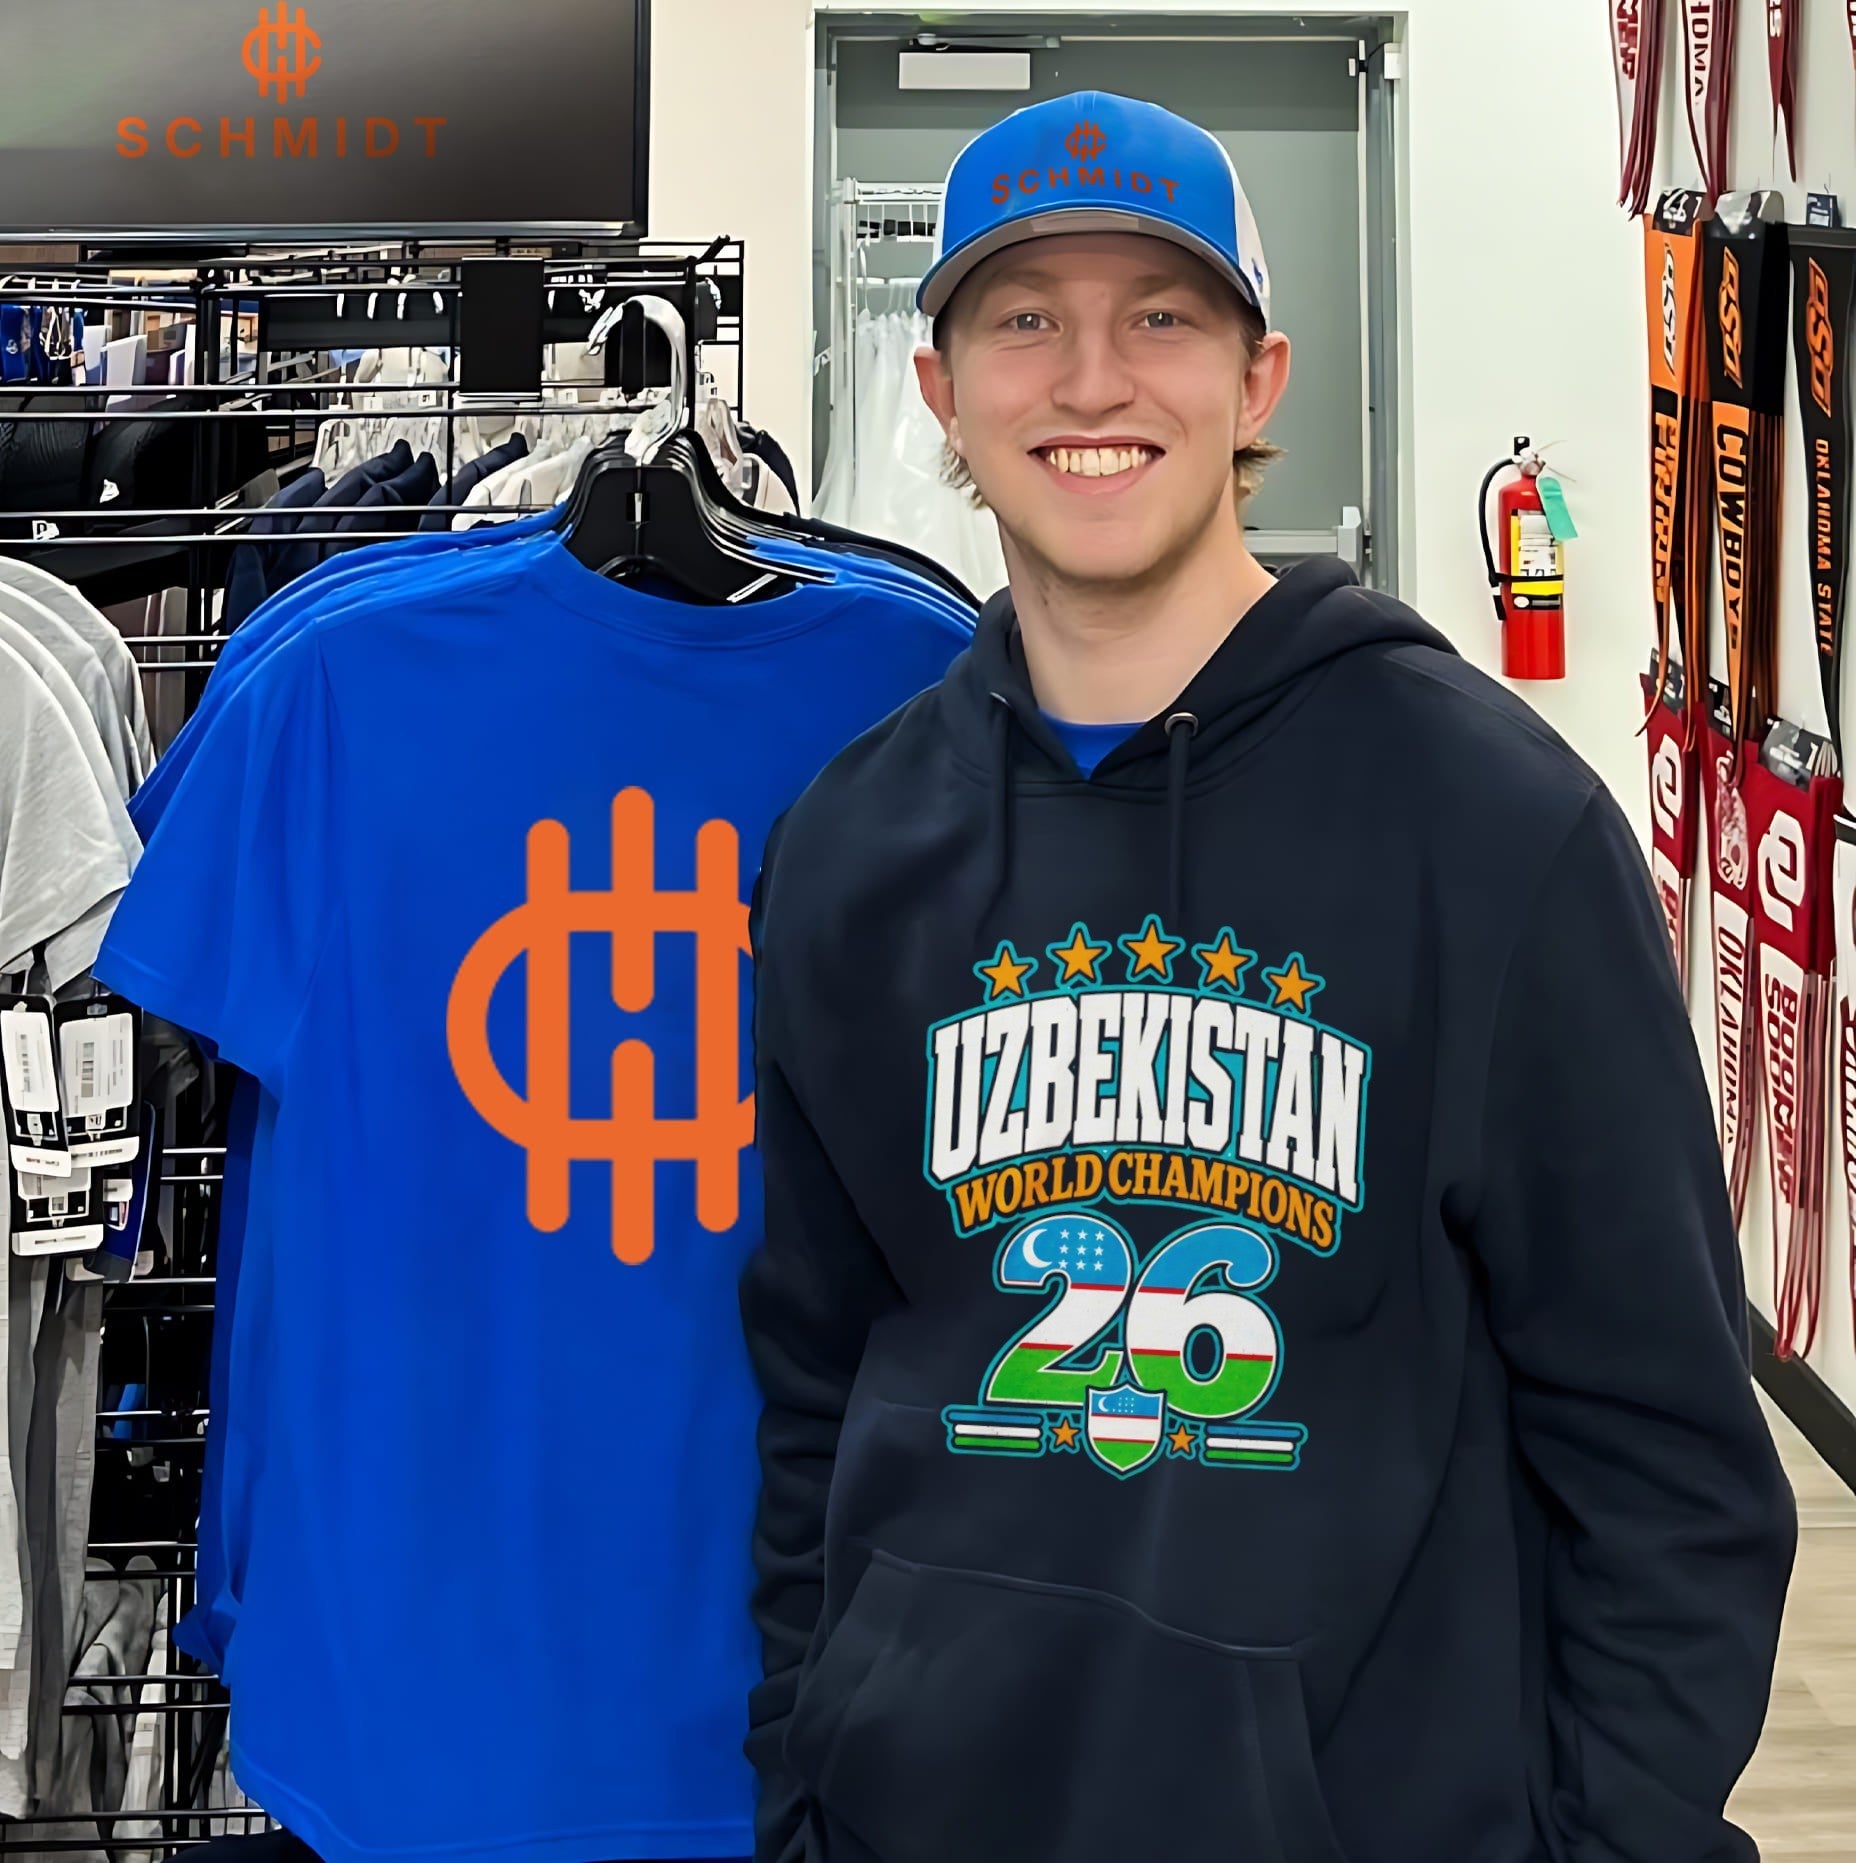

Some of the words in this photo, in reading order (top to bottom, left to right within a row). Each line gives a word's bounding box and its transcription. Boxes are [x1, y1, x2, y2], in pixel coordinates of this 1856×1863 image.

[115, 116, 447, 159] SCHMIDT
[991, 167, 1179, 205] SCHMIDT
[1815, 438, 1831, 569] OKLAHOMA
[930, 991, 1365, 1205] UZBEKISTAN
[954, 1159, 1103, 1230] WORLD
[1108, 1151, 1335, 1249] CHAMPIONS
[985, 1213, 1277, 1420] 26
